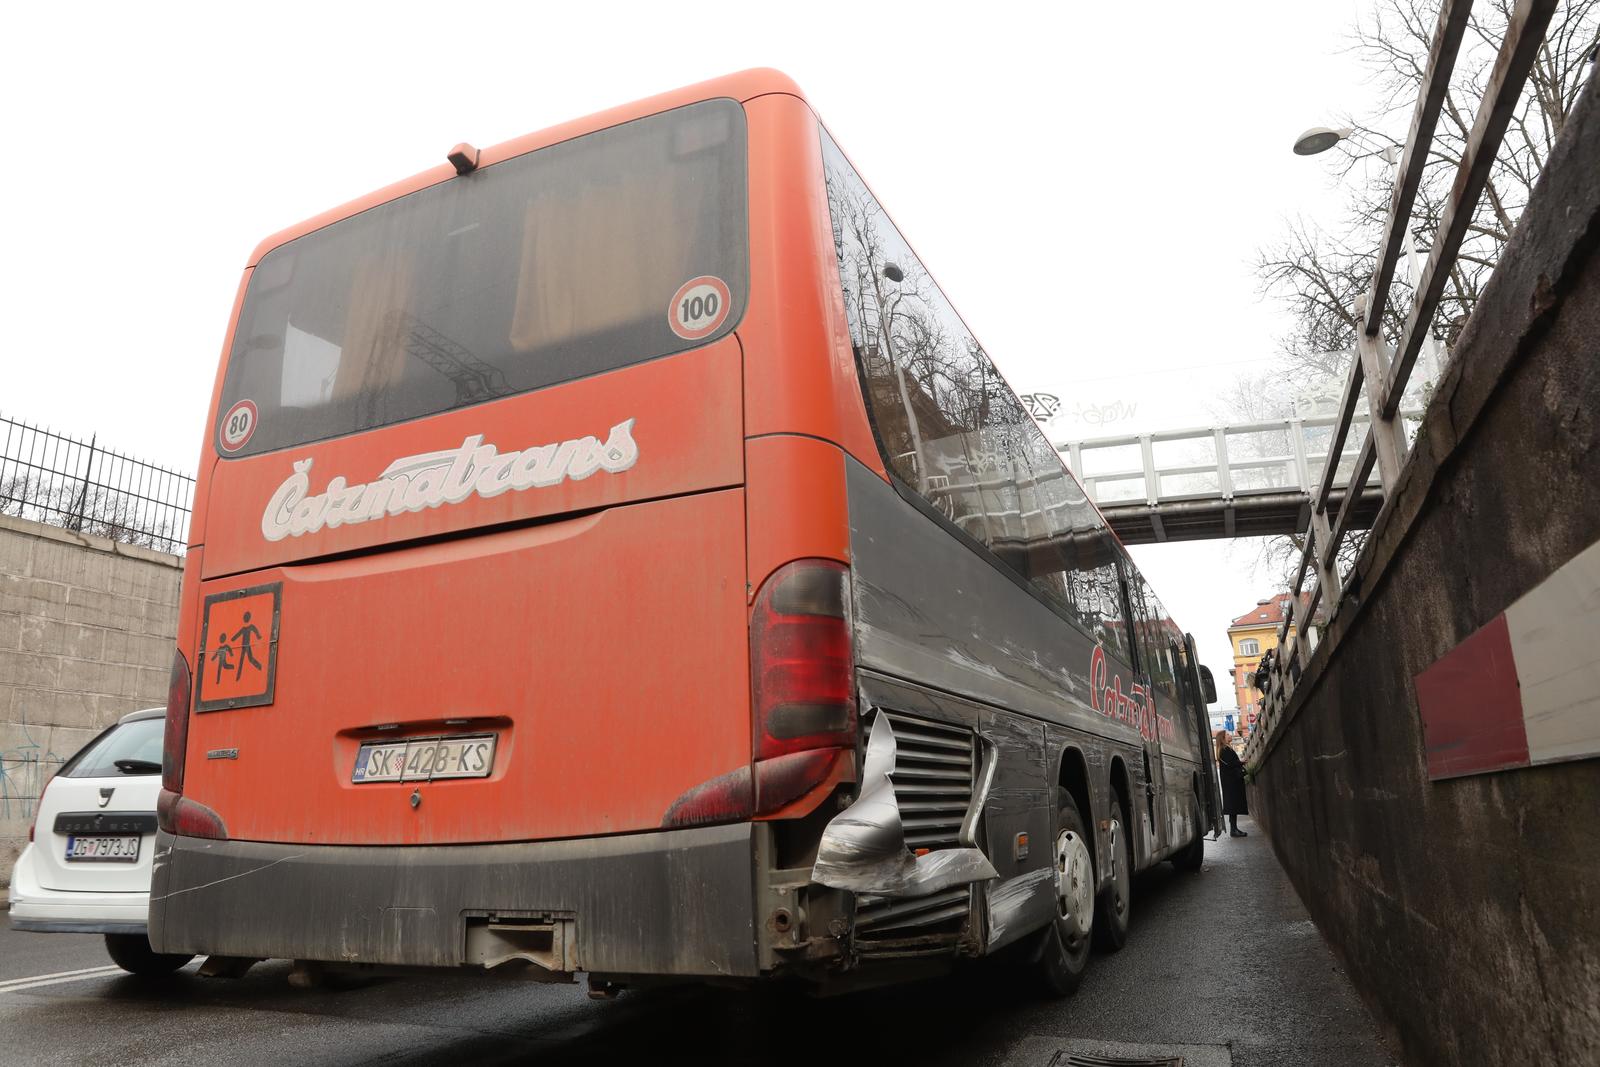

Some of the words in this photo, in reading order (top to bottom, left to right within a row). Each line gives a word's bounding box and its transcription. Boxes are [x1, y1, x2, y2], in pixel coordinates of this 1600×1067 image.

[681, 293, 719, 323] 100
[229, 413, 248, 435] 80
[354, 767, 366, 776] HR
[368, 749, 395, 777] SK
[74, 838, 89, 856] ZG
